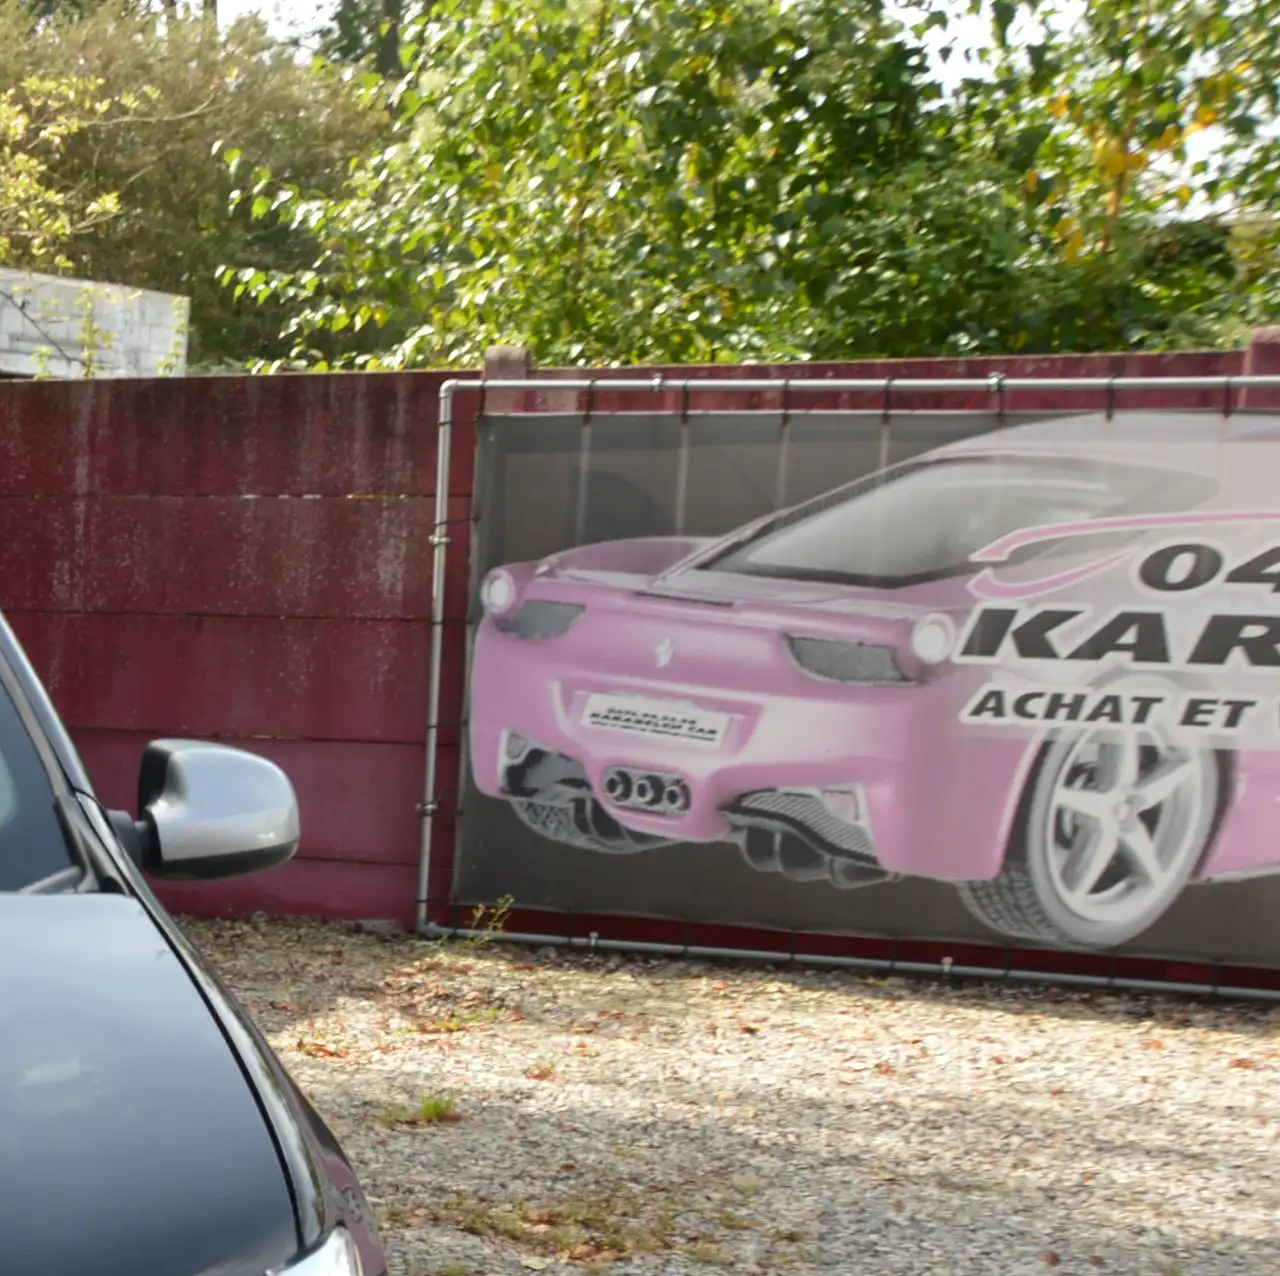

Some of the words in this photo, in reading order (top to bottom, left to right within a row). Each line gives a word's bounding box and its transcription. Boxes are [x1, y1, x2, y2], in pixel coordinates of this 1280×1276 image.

[959, 608, 1280, 667] KAR
[967, 690, 1165, 724] ACHAT
[1179, 698, 1258, 728] ET
